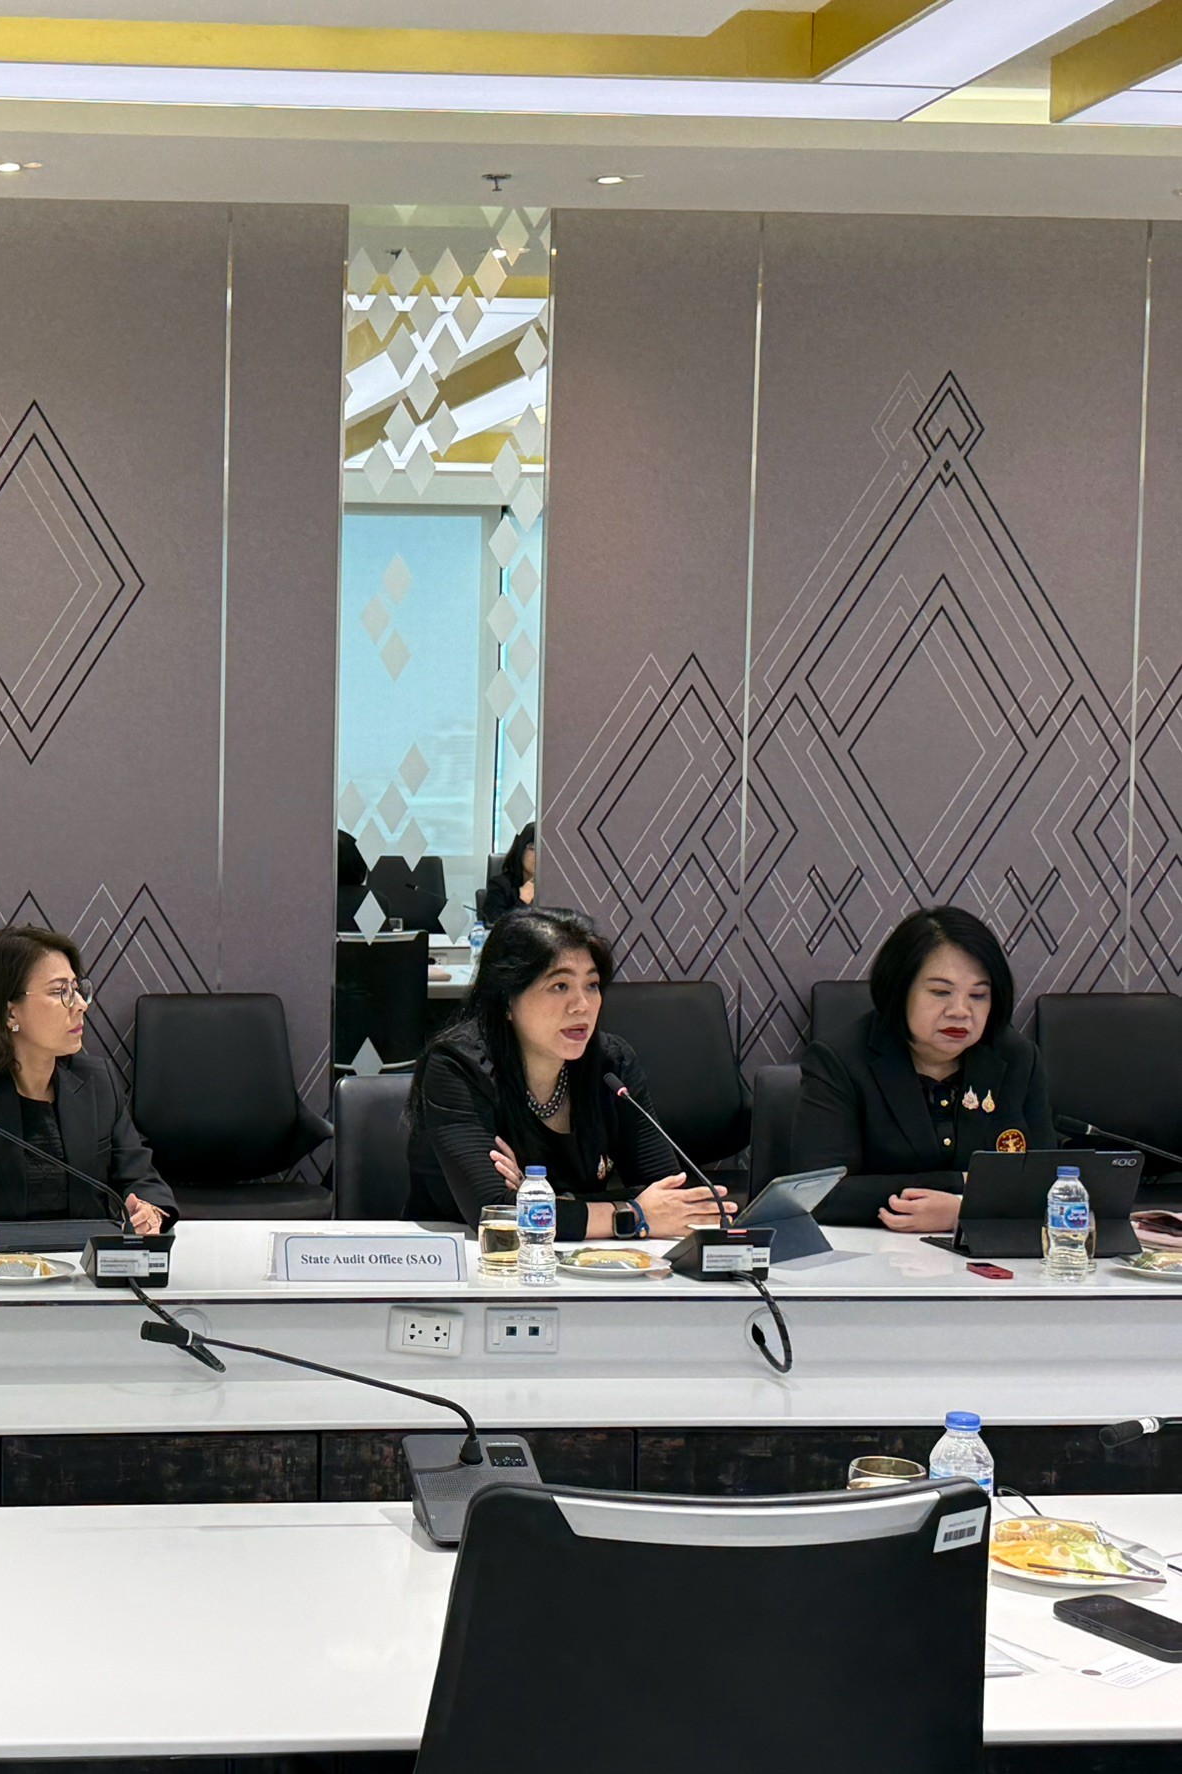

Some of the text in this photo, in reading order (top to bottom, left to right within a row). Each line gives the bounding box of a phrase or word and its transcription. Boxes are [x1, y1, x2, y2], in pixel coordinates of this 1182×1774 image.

[300, 1253, 442, 1266] State Audit Office (SAO)
